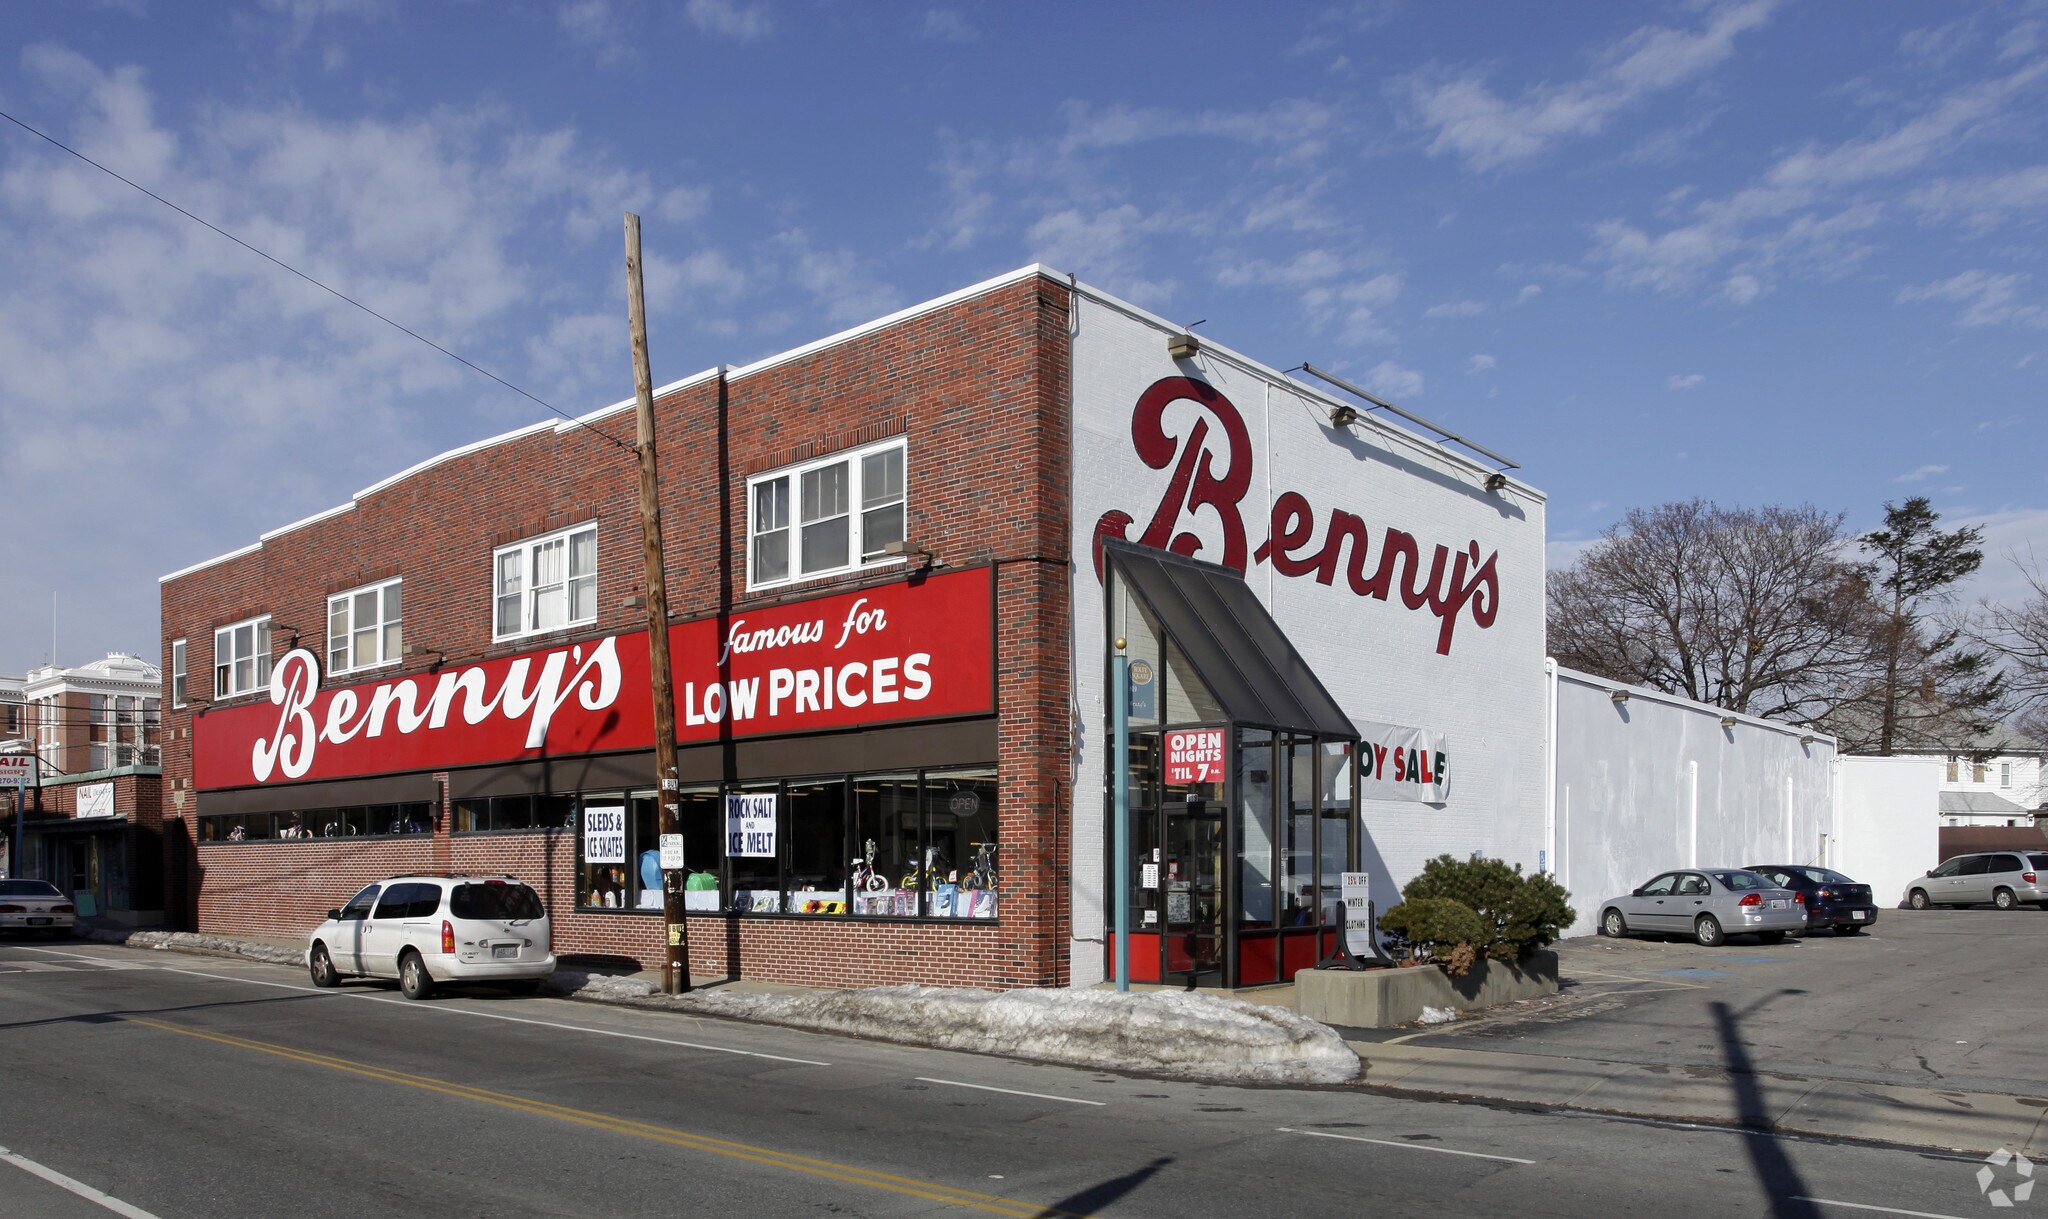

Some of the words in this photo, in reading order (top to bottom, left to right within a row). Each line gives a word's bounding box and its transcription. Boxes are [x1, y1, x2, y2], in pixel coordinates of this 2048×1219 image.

[1092, 376, 1499, 655] Benny's
[717, 620, 824, 666] famous
[834, 598, 887, 649] for
[685, 677, 760, 726] LOW
[769, 652, 932, 717] PRICES
[252, 636, 622, 782] Benny's
[1170, 732, 1221, 751] OPEN
[1170, 749, 1221, 763] NIGHTS
[1351, 741, 1388, 781] OY
[1393, 746, 1445, 786] SALE
[1171, 767, 1193, 780] 'TIL
[1197, 763, 1209, 782] 7
[728, 798, 751, 819] ROCK
[753, 797, 772, 818] SALT
[951, 797, 978, 810] OPEN
[587, 812, 614, 832] SLEDS
[616, 814, 622, 831] &
[587, 837, 597, 857] ICE
[599, 836, 623, 857] SKATES
[728, 832, 744, 853] ICE
[746, 832, 773, 853] MELT
[1358, 876, 1367, 885] OFF
[1347, 898, 1363, 907] WINTER
[1345, 920, 1366, 929] CLOTHING
